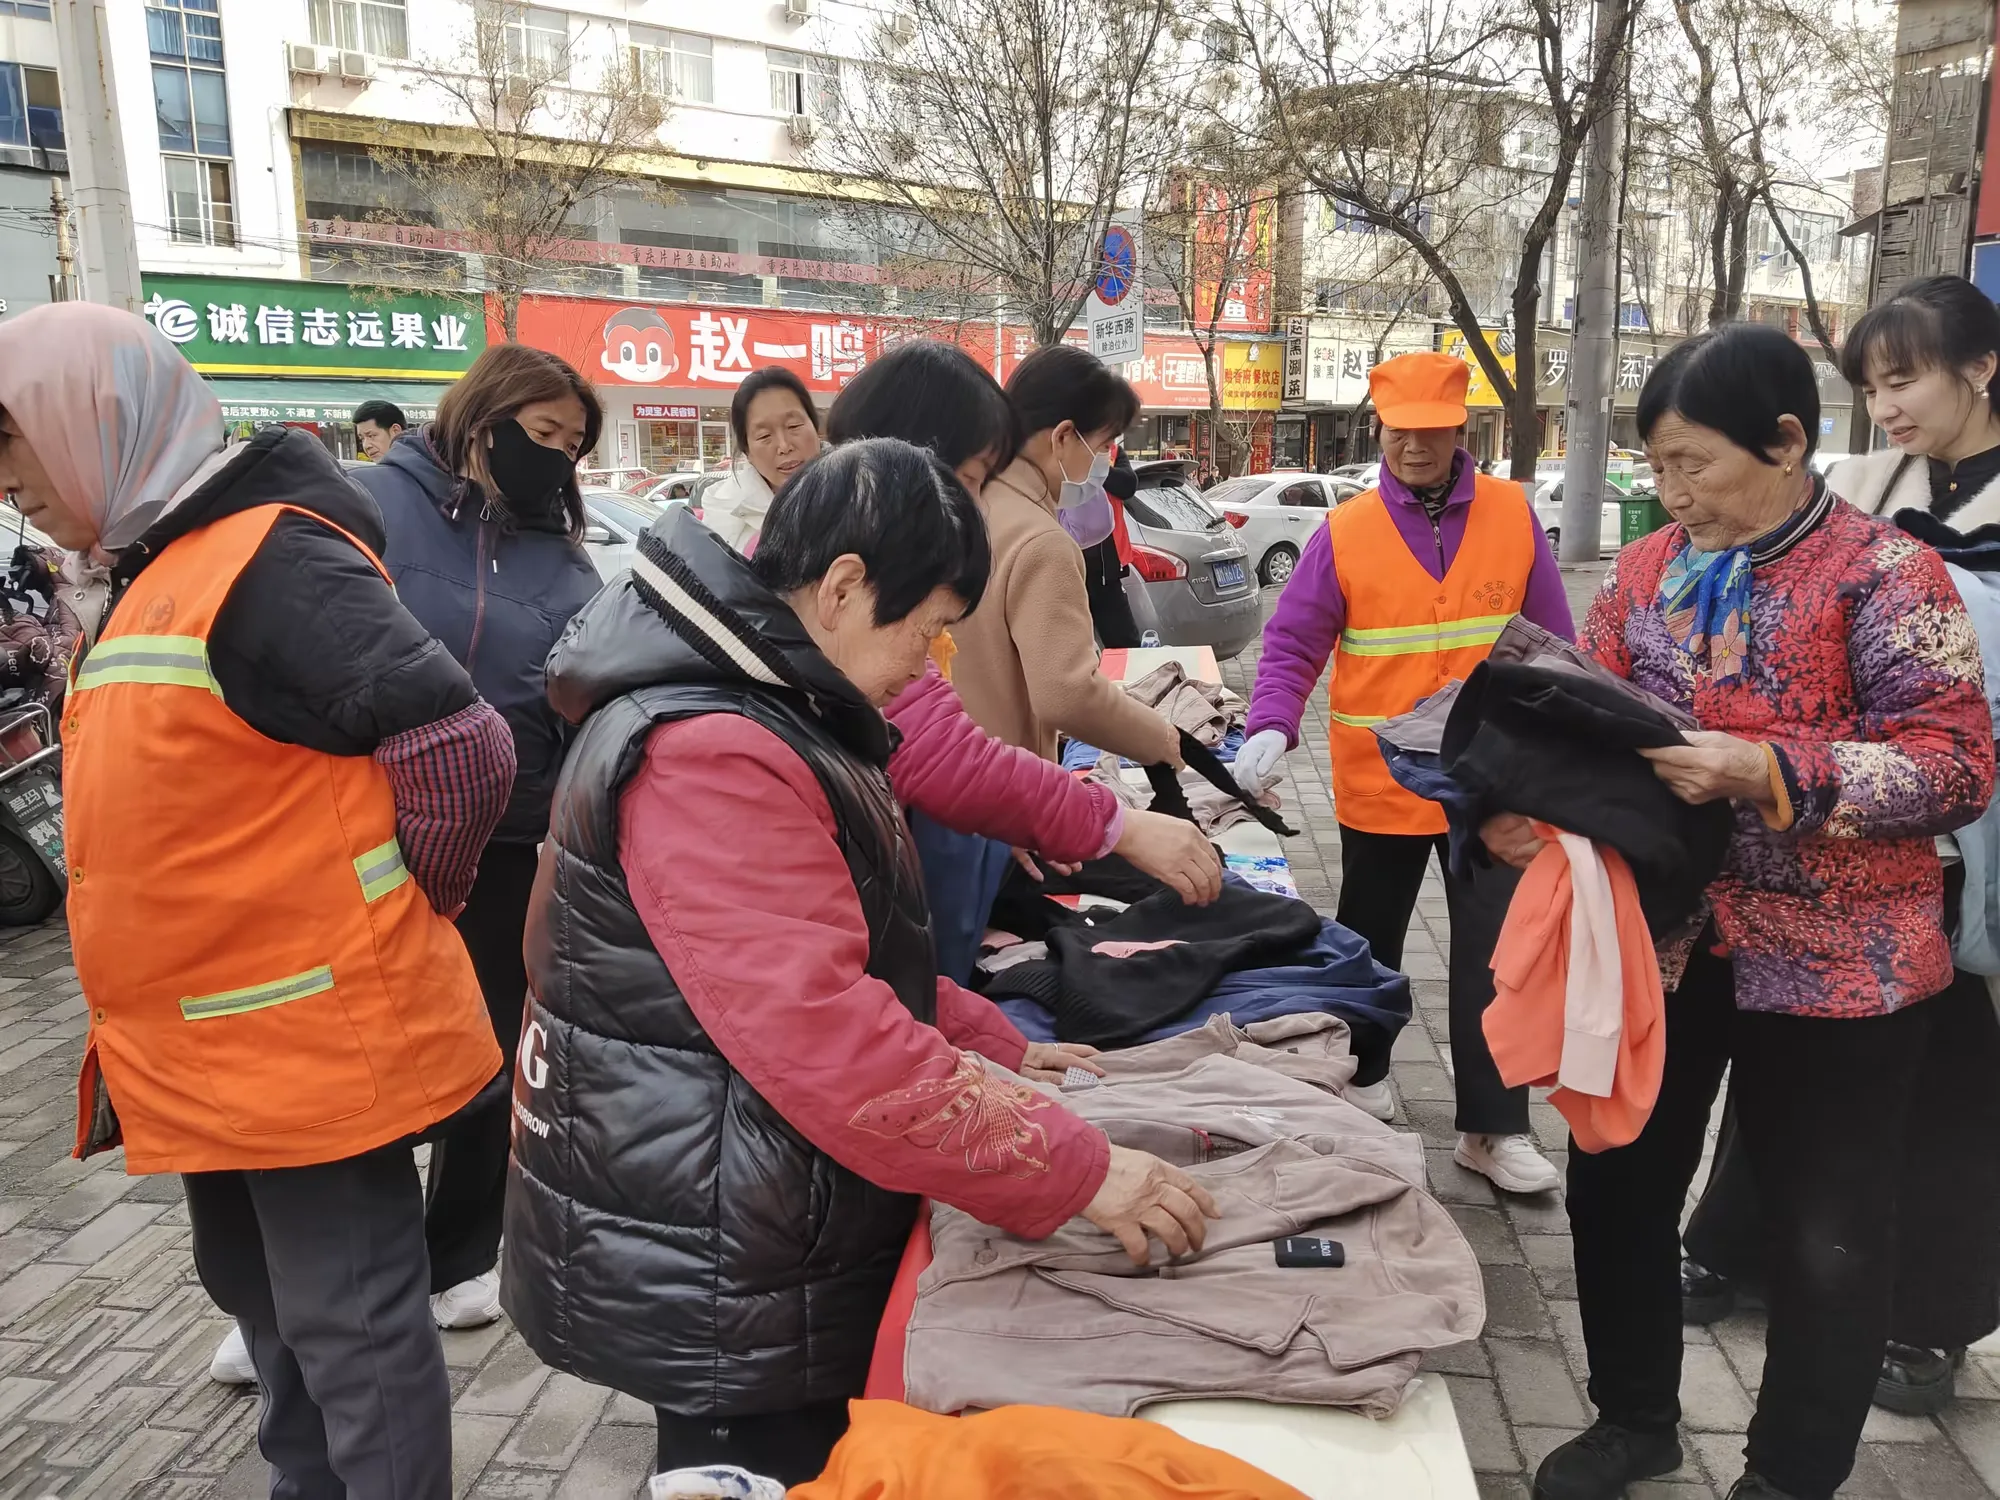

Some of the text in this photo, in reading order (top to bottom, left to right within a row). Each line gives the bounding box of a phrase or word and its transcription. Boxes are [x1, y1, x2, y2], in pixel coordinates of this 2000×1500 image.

[206, 302, 468, 351] 诚信志远果业
[1095, 316, 1134, 340] 新华西路
[636, 406, 697, 418] 为灵宝人民省钱
[1472, 580, 1516, 603] 灵宝环卫
[9, 788, 41, 813] 爱玛
